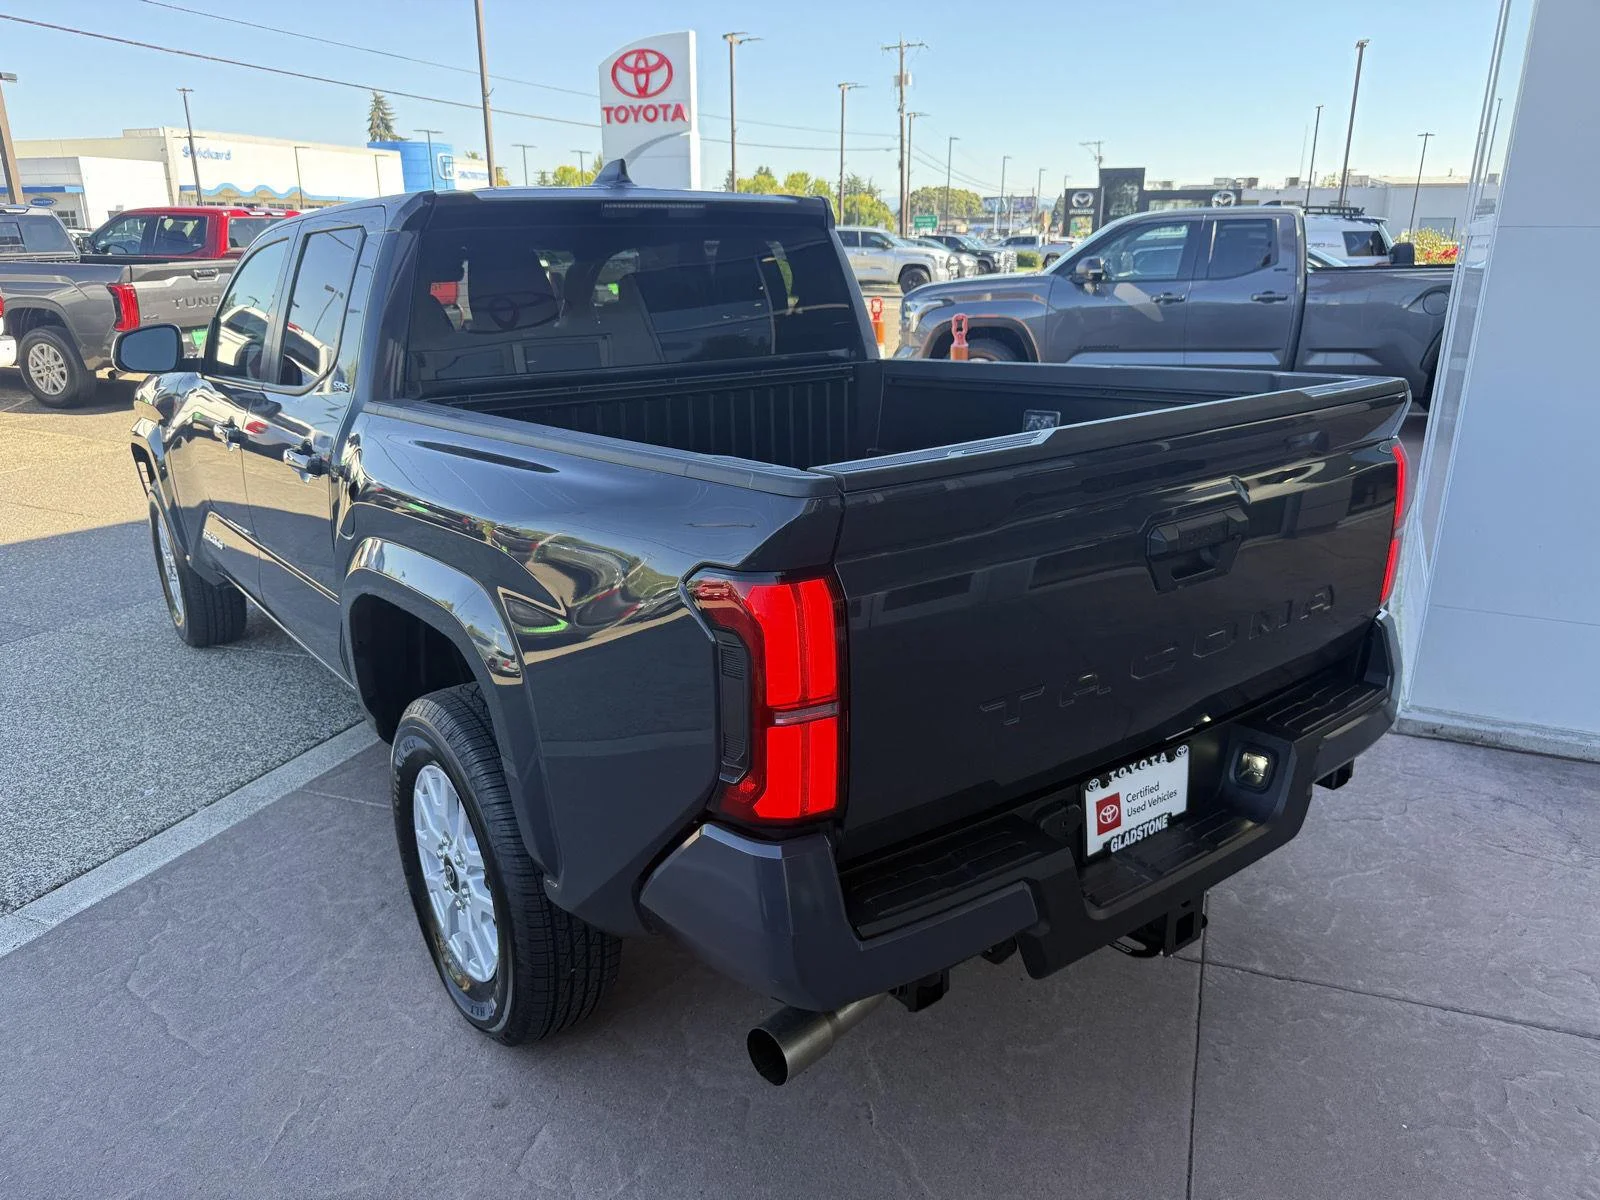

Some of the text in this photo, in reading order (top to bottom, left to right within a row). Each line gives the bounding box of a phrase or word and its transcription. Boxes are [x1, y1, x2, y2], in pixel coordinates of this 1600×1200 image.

[602, 103, 688, 124] TOYOTA
[980, 585, 1335, 726] TACOMA
[1109, 752, 1168, 781] TOYOTA
[1126, 781, 1160, 803] Certified
[1127, 789, 1178, 817] Used Vehicles
[1110, 813, 1168, 852] GLADSTONE
